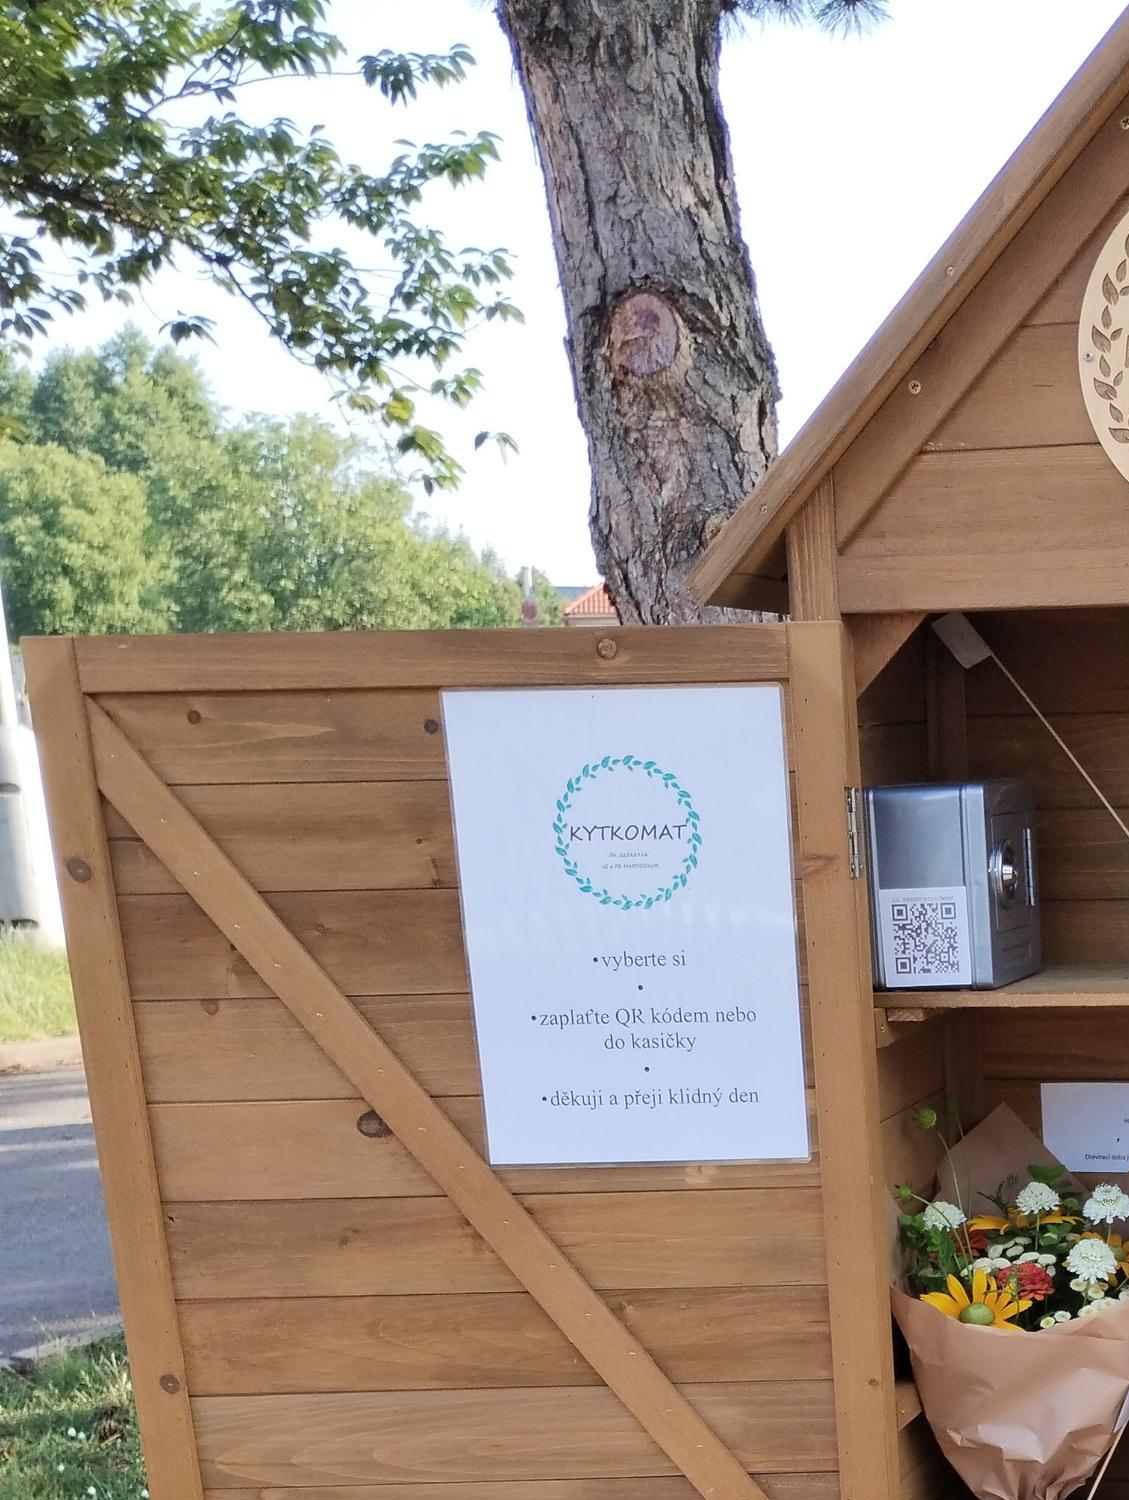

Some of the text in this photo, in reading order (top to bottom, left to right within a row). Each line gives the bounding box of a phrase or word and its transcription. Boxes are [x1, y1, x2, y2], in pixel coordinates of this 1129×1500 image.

[570, 824, 687, 841] KYTKOMAT
[601, 949, 686, 971] vyberte si
[540, 1006, 757, 1029] zaplaťte QR kódem nebo
[604, 1033, 696, 1052] do kasičky
[551, 1088, 759, 1110] děkuji a přeji klidný den
